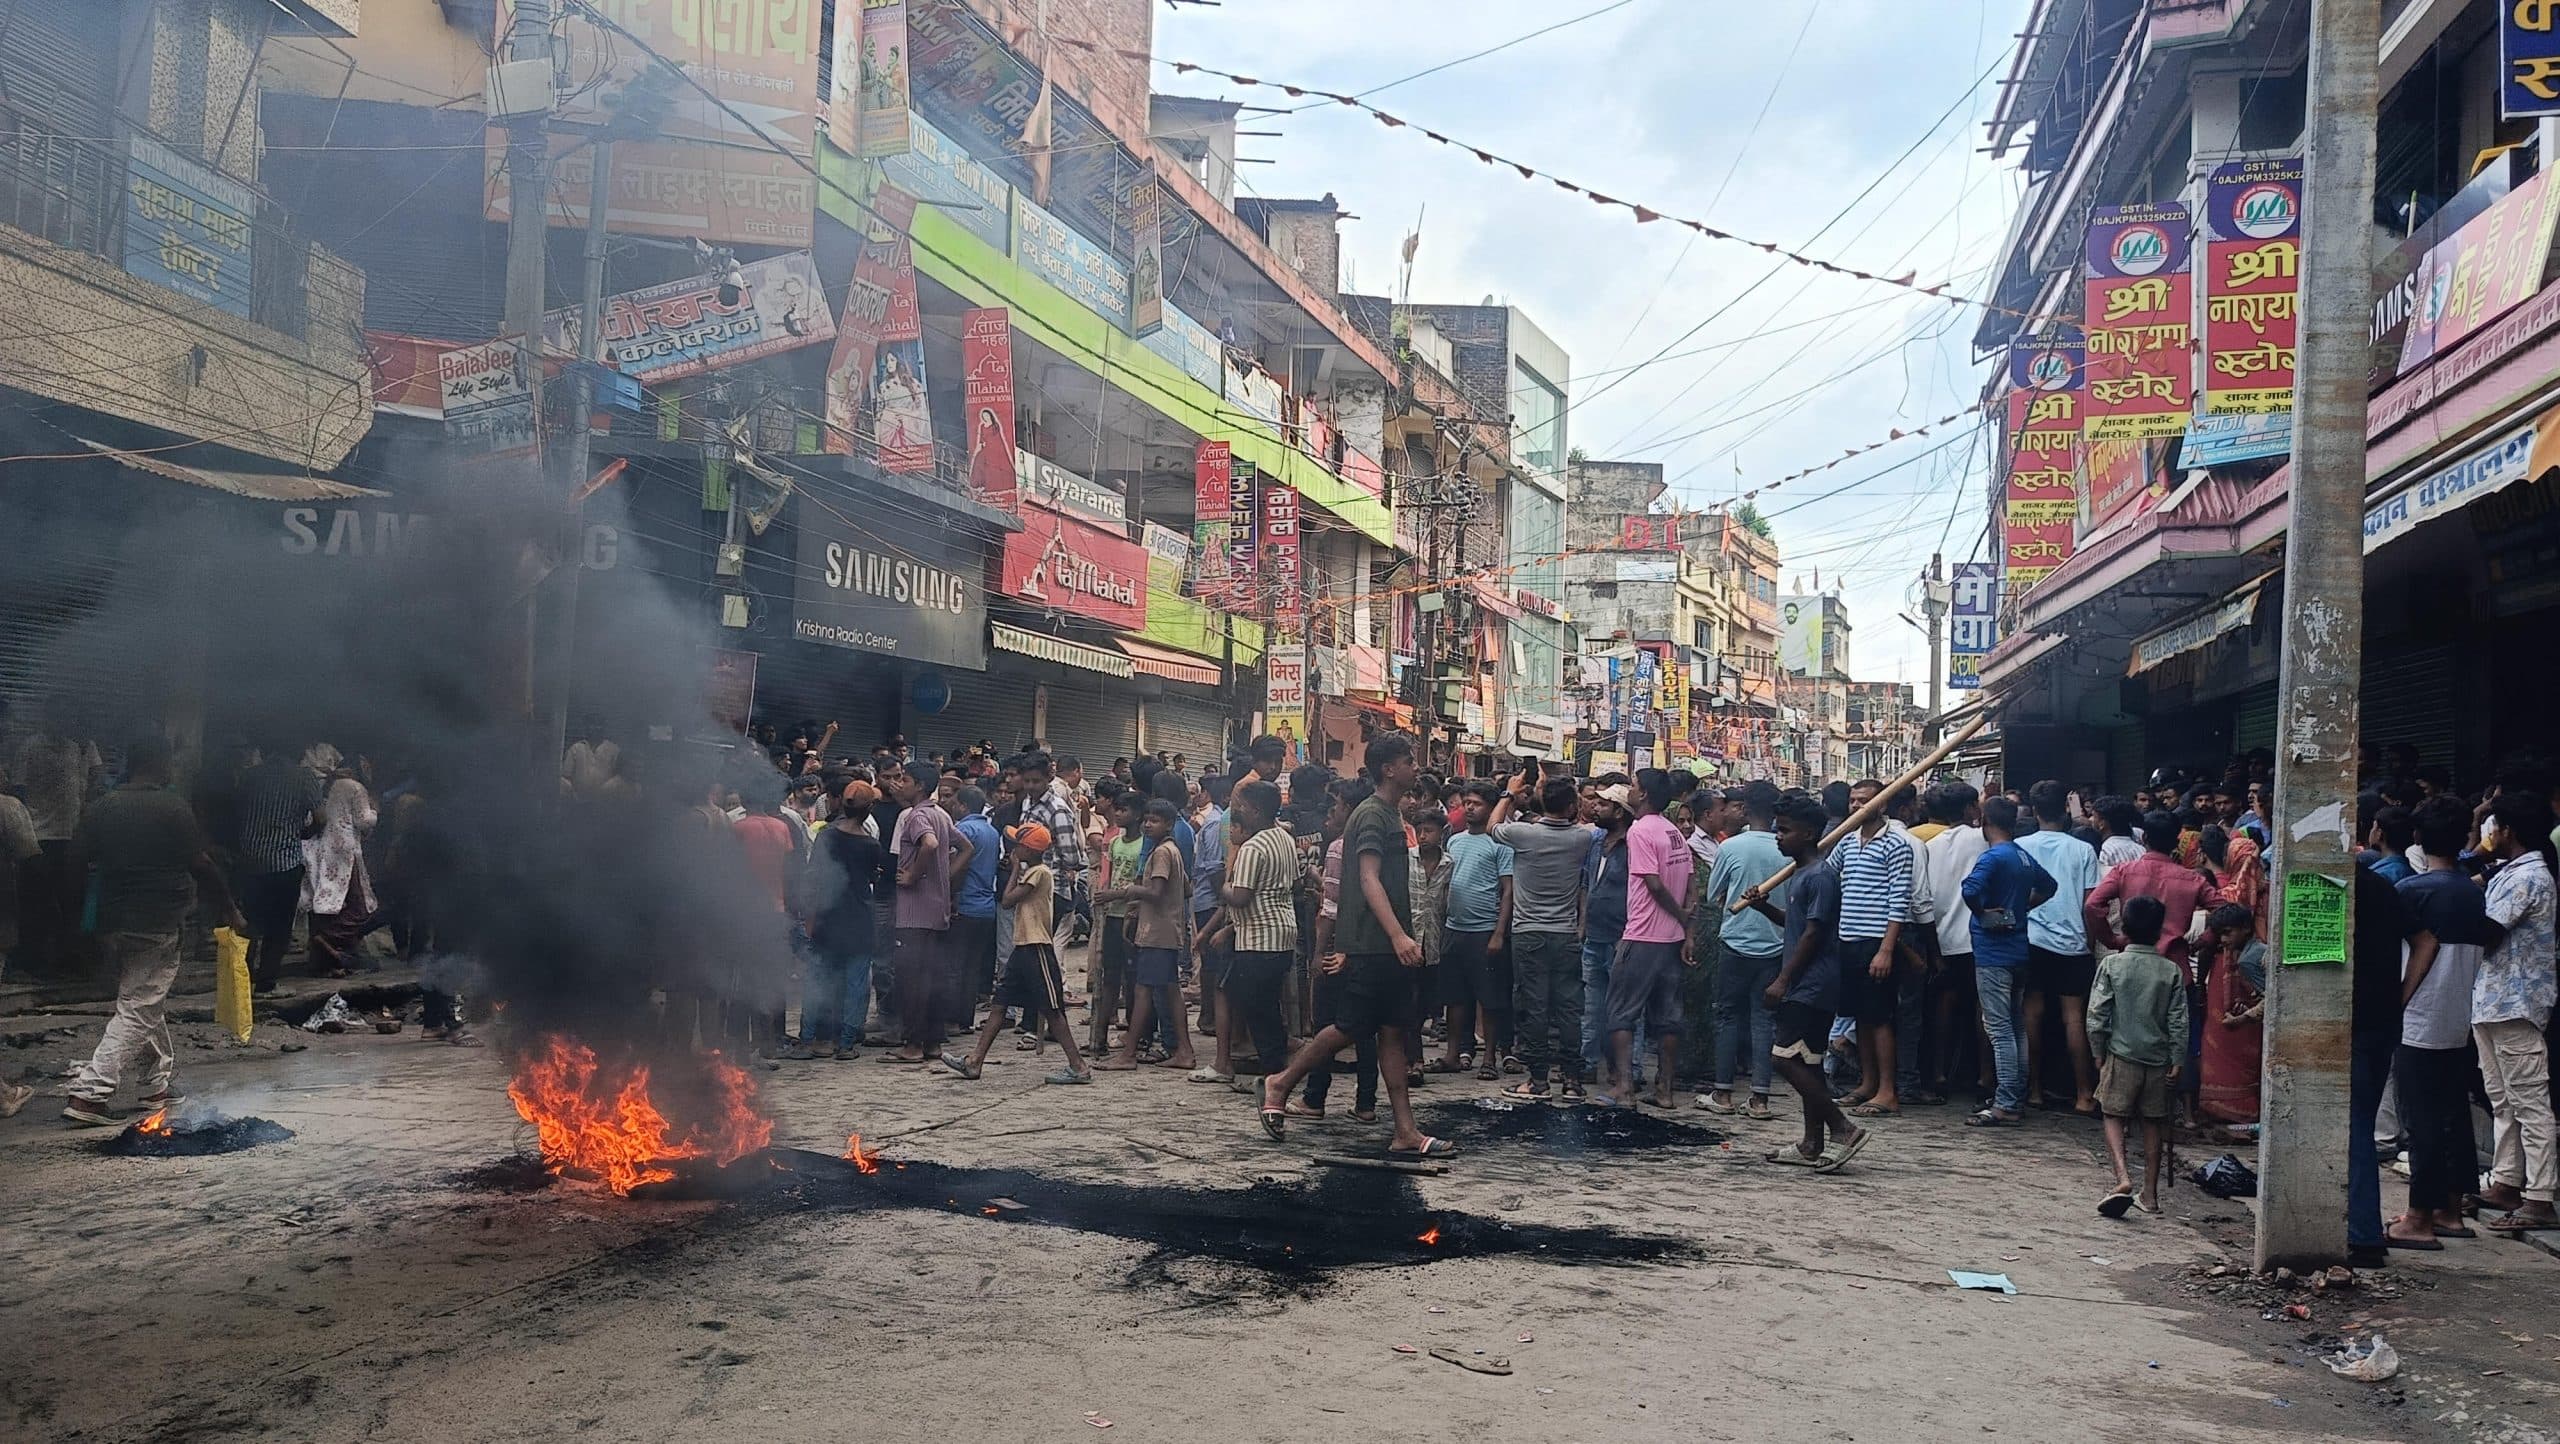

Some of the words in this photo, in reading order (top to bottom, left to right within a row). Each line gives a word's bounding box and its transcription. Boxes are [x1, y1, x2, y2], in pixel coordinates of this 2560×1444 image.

[2243, 163, 2265, 172] GST
[954, 154, 981, 194] SHOW
[982, 174, 1008, 215] ROOM
[2120, 205, 2141, 214] GST
[2143, 204, 2157, 212] IN-
[2226, 241, 2302, 287] श्री
[2104, 278, 2173, 322] श्री
[883, 316, 918, 332] ahal
[977, 318, 1008, 336] ताज
[980, 335, 1008, 348] महल
[988, 358, 1010, 377] Taj
[448, 382, 474, 398] Life
[478, 374, 511, 391] Style
[967, 379, 1011, 395] Mahal
[2091, 370, 2185, 405] स्टोर
[2224, 391, 2259, 401] सागर
[2024, 393, 2076, 425] श्री
[2263, 403, 2293, 414] जोग
[2102, 416, 2134, 427] सागर
[1040, 465, 1125, 520] Siyarams
[1197, 499, 1227, 511] Mahal
[281, 506, 619, 570] SAMG
[2010, 539, 2069, 561] स्टोर
[825, 541, 966, 615] SAMSUNG
[795, 617, 835, 641] Krishna
[836, 625, 863, 645] Radio
[865, 628, 897, 652] Center
[1269, 657, 1301, 682] मिस
[1269, 683, 1302, 705] आर्ट
